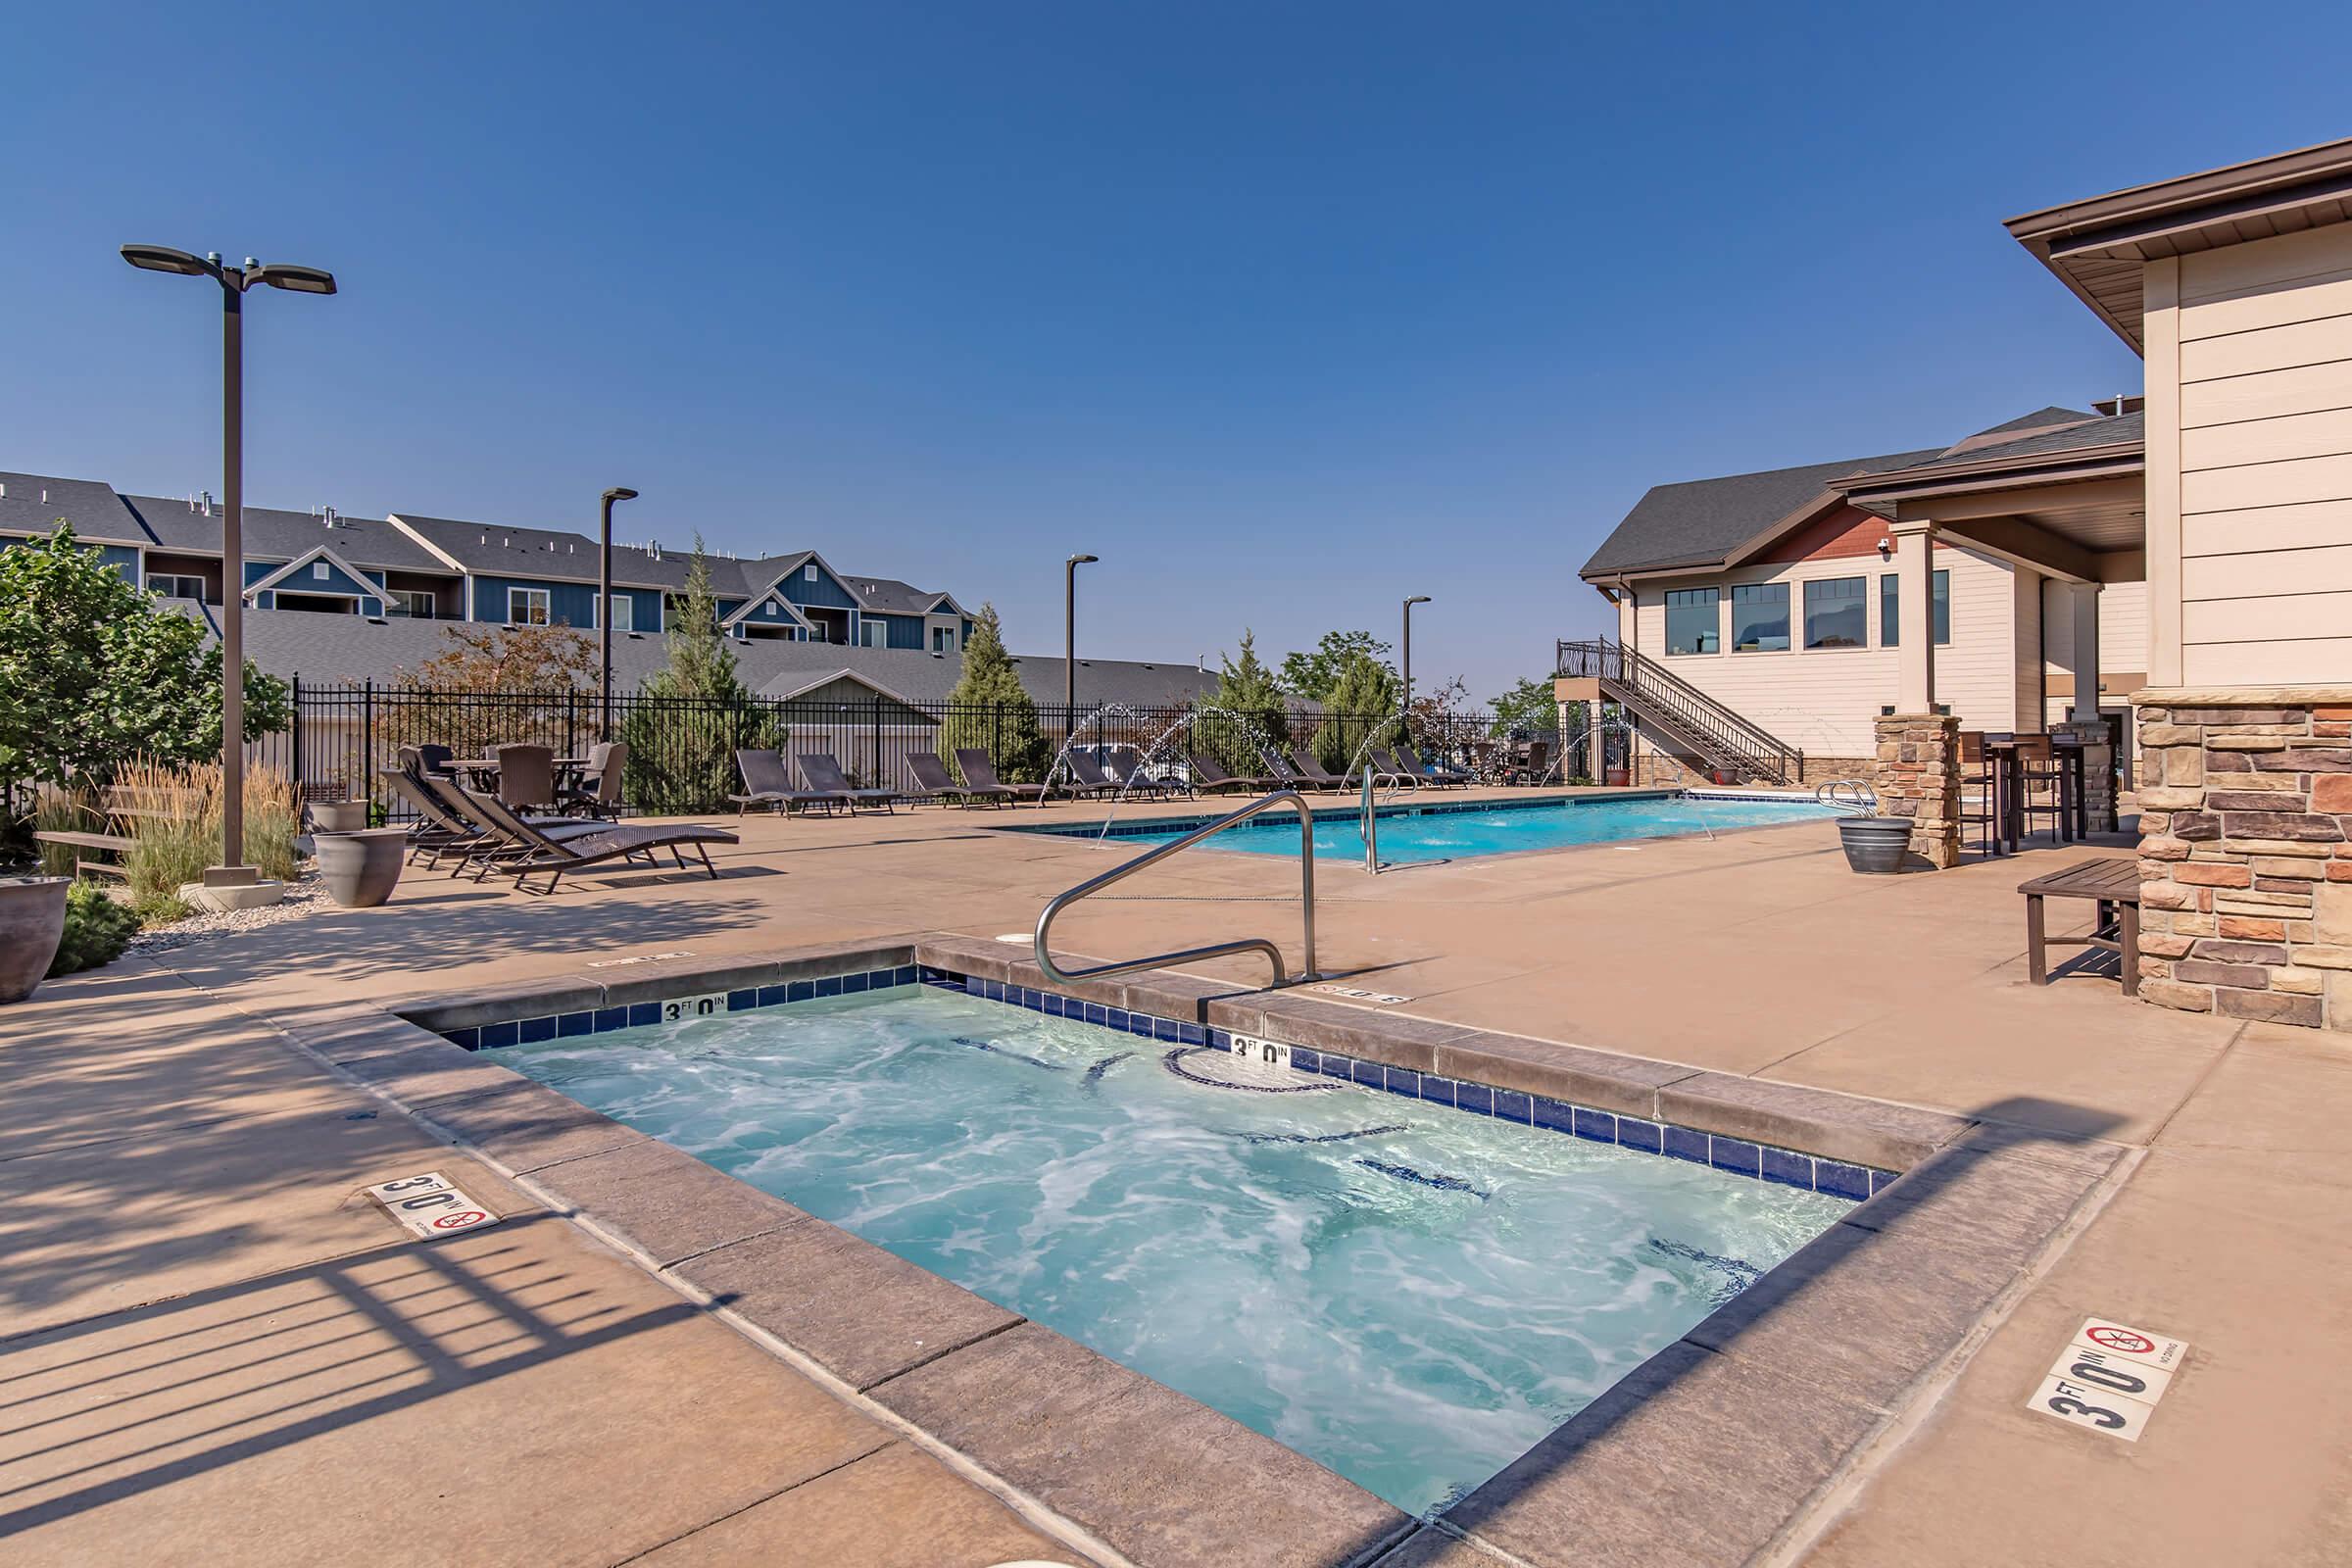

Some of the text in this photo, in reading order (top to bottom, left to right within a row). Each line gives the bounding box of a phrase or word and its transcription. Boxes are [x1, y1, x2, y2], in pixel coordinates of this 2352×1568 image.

[665, 996, 724, 1021] 3 FT 0 IN
[1235, 1038, 1288, 1062] 3 FT 0 IN
[382, 1176, 433, 1192] 3
[401, 1193, 455, 1210] 0
[2048, 1349, 2146, 1429] 3 FT 0 IN
